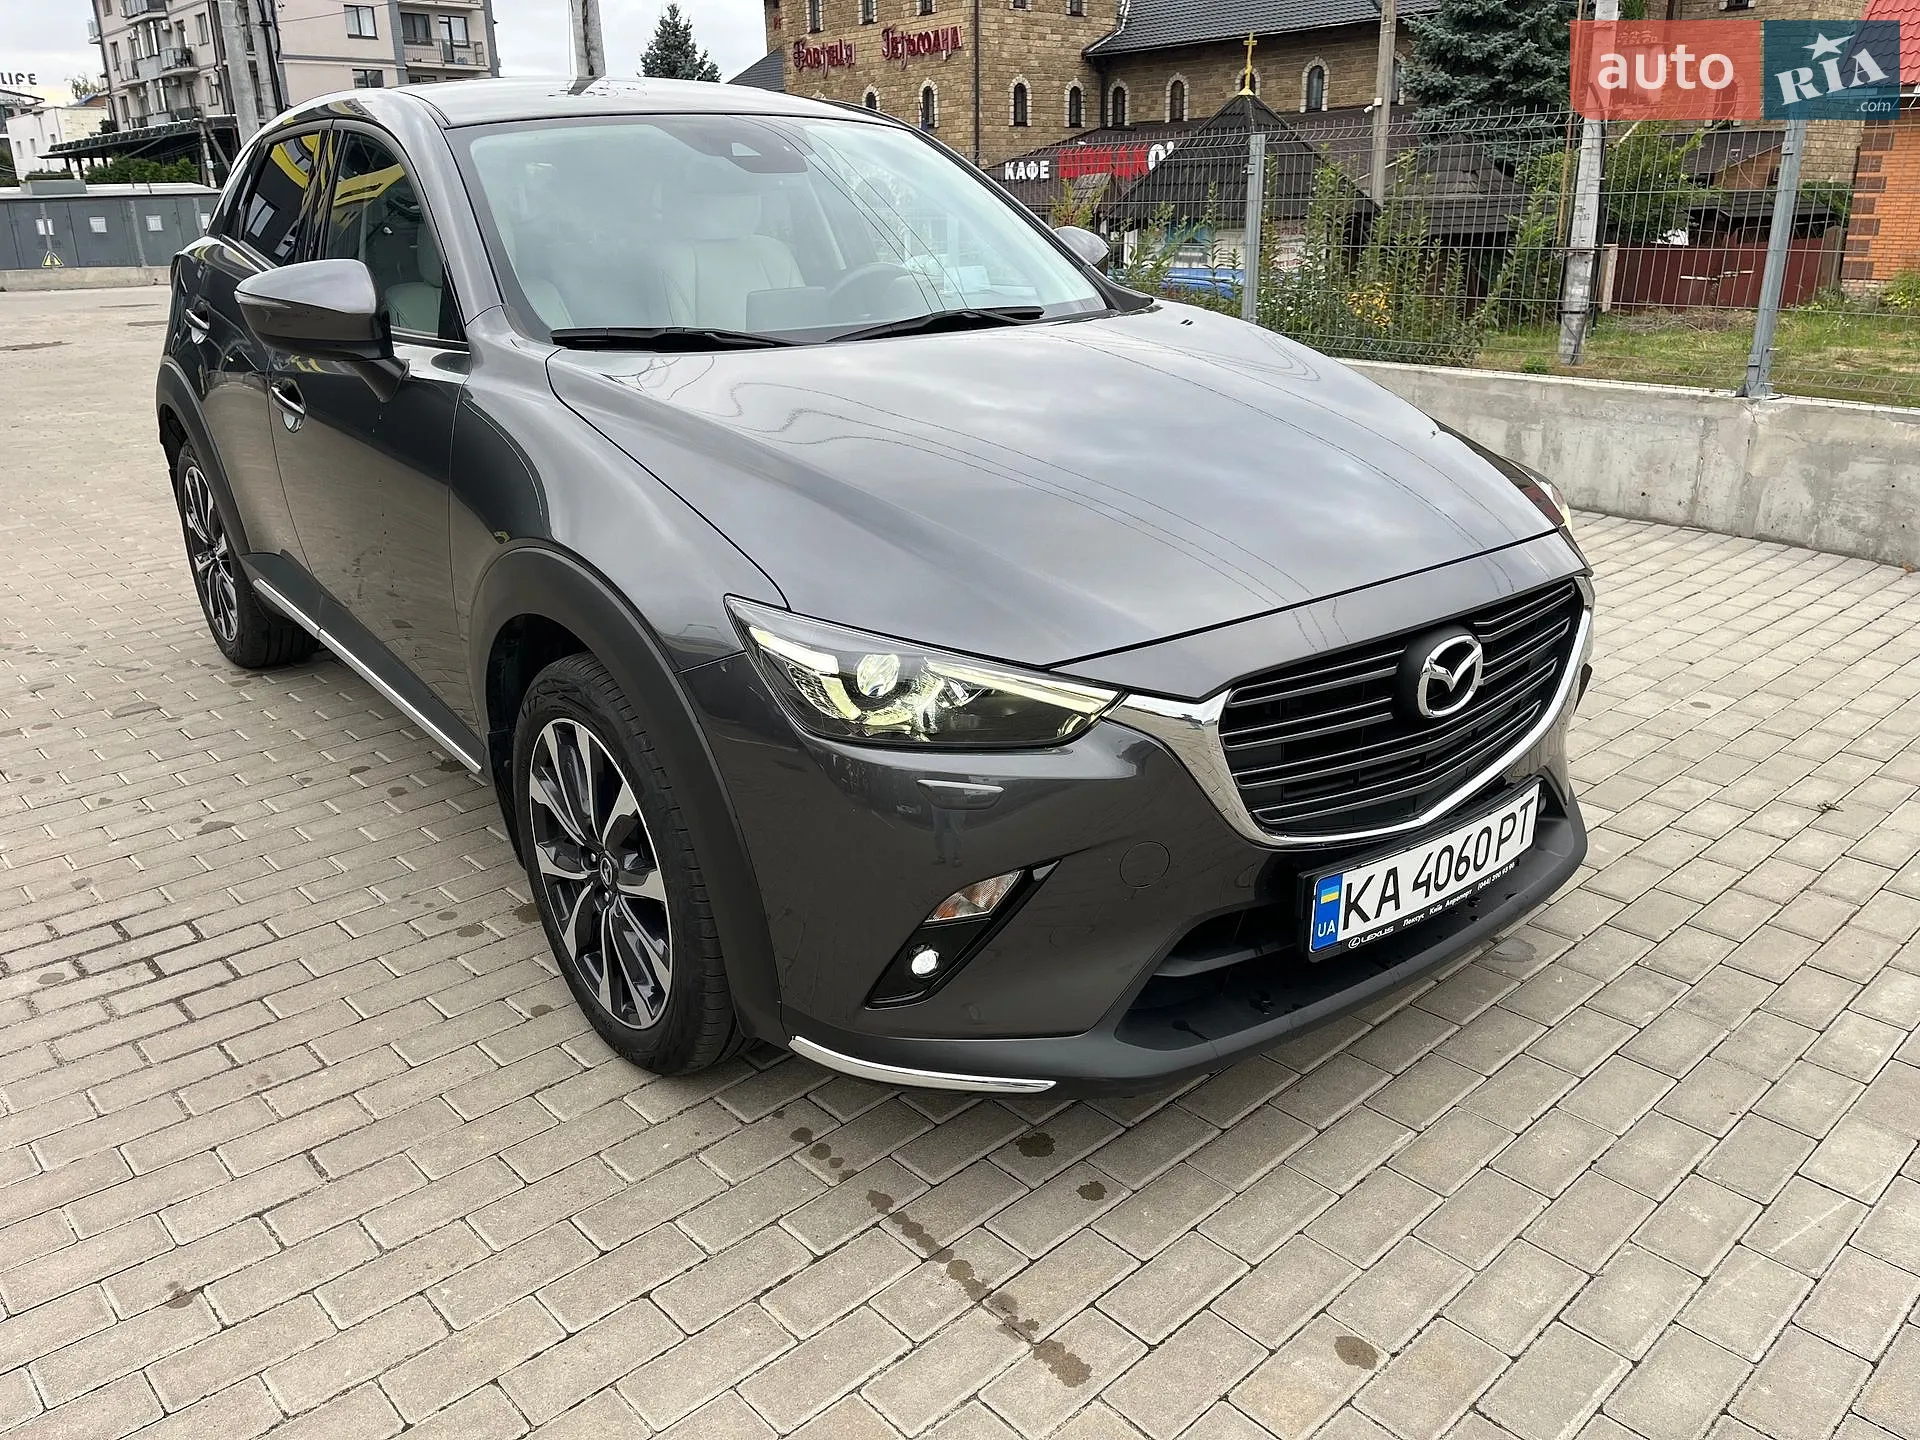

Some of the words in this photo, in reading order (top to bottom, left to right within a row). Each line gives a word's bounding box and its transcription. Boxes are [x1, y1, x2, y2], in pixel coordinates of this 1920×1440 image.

[1004, 160, 1050, 181] КАФЕ
[1343, 866, 1401, 931] KA
[1411, 825, 1492, 899] 4060
[1494, 796, 1535, 863] PT
[1317, 922, 1336, 938] UA
[1361, 926, 1394, 943] LEXUS
